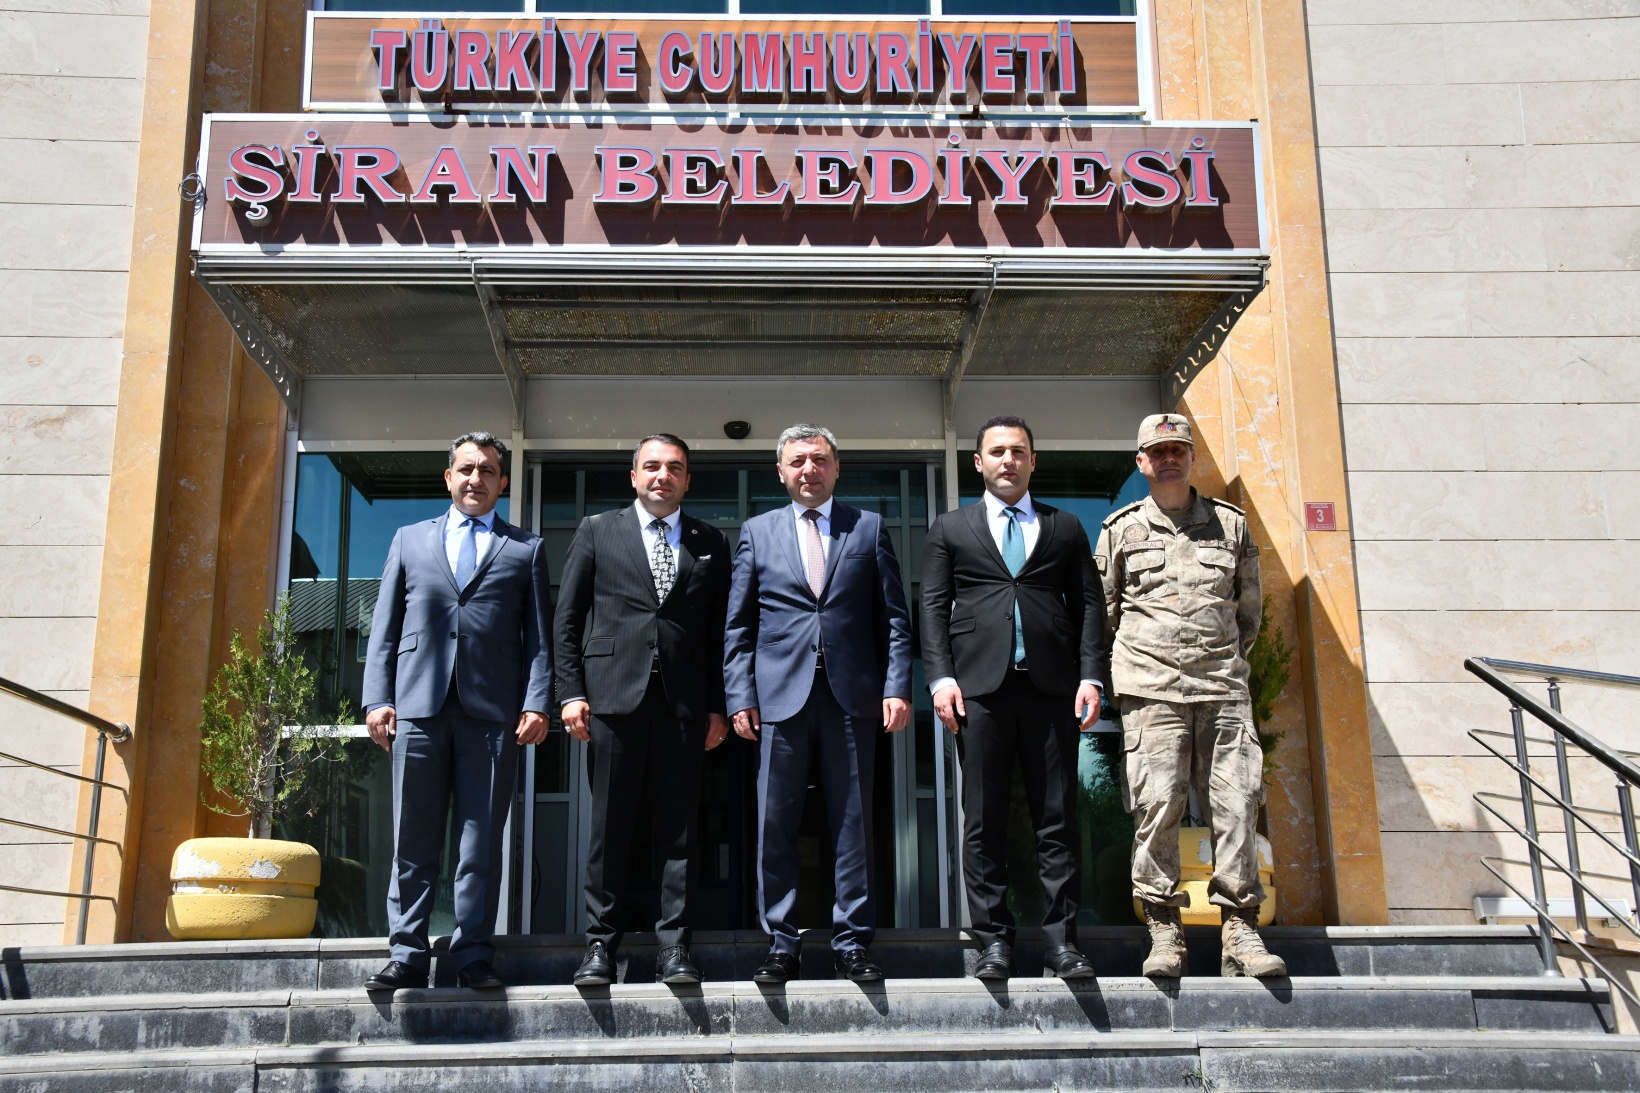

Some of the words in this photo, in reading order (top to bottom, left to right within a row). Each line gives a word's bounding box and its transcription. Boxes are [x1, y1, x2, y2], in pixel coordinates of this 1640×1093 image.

[371, 17, 637, 92] TÜRKİYE
[658, 18, 1076, 94] CUMHURİYETİ
[224, 130, 557, 219] ŞİRAN
[592, 133, 1219, 207] BELEDİYESİ
[1316, 509, 1324, 522] 3
